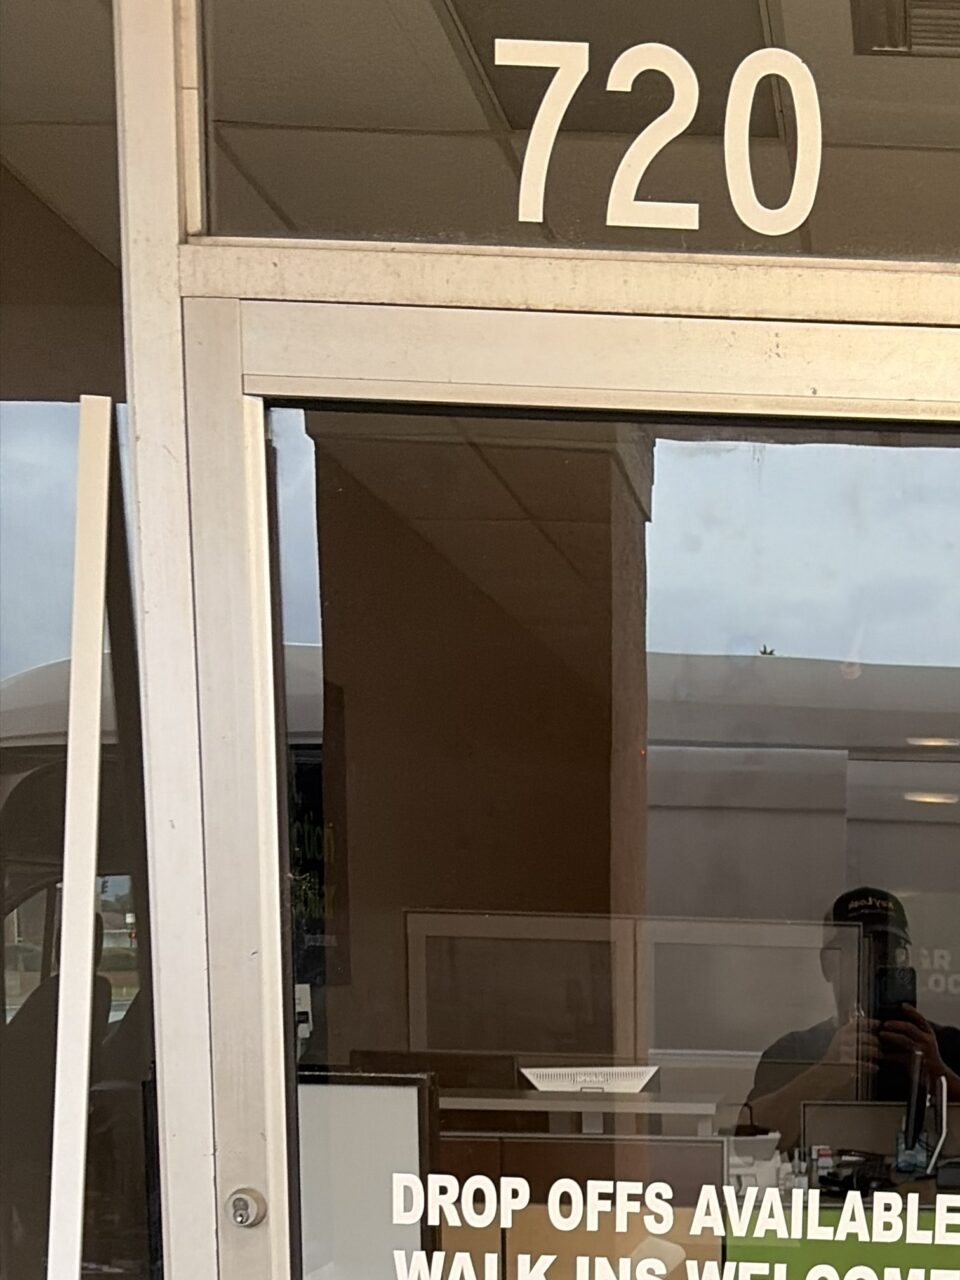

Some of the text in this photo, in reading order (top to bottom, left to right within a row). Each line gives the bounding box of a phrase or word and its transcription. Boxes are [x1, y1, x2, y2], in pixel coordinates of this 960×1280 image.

[495, 38, 822, 237] 720
[392, 1172, 530, 1230] DROP
[547, 1178, 674, 1236] OFFS
